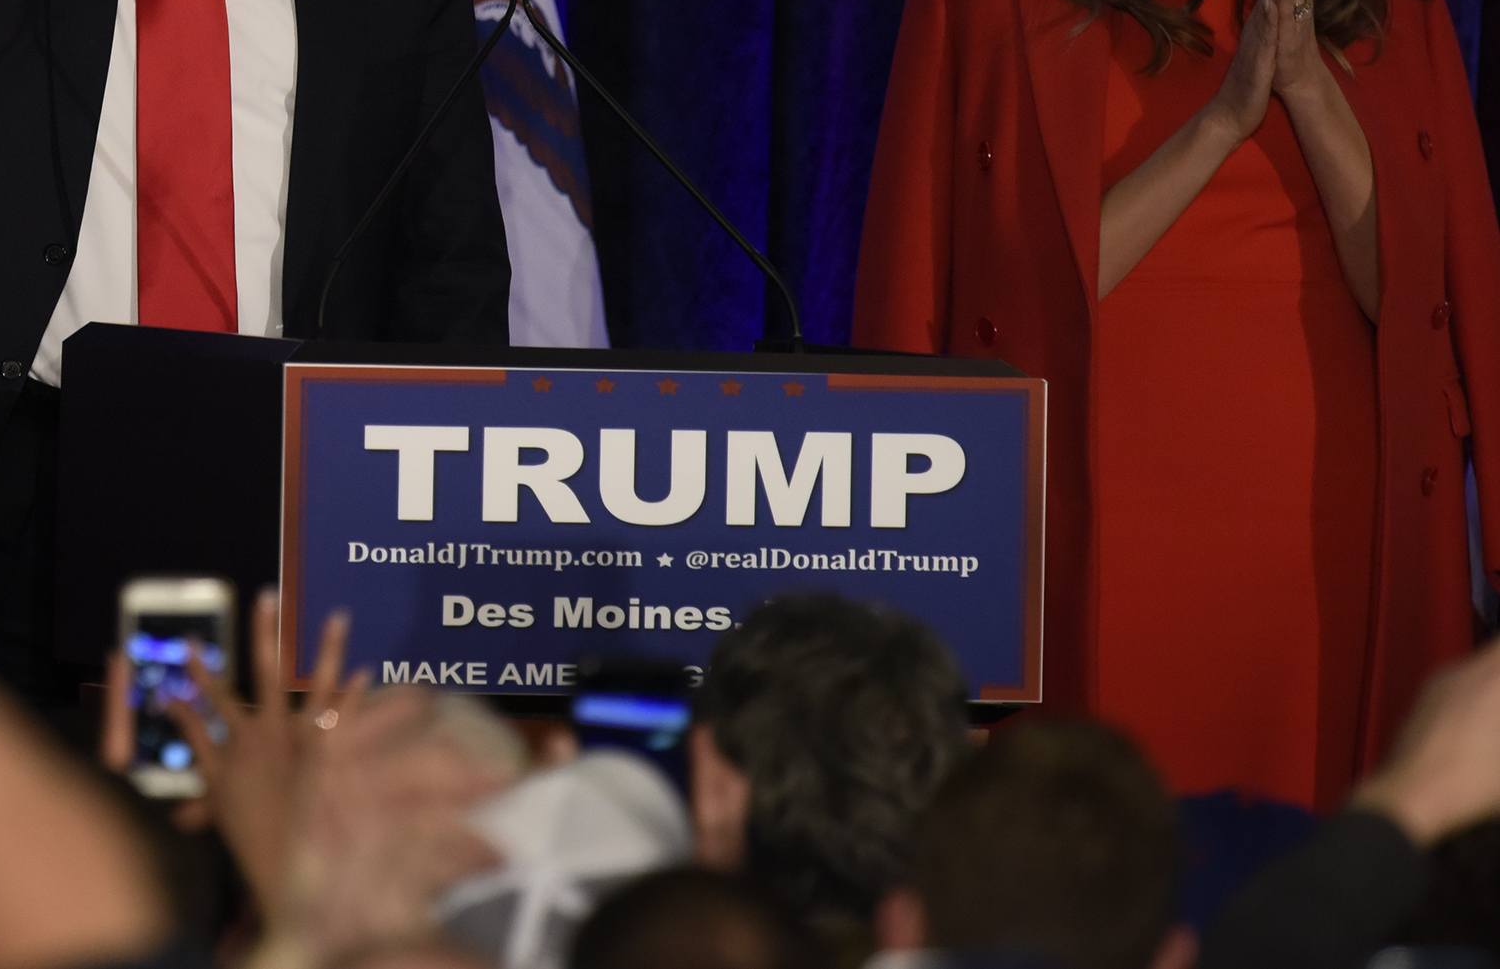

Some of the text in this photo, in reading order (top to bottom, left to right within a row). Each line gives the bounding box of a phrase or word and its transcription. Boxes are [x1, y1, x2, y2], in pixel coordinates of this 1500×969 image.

[363, 424, 966, 529] TRUMP
[347, 540, 980, 578] DonaldJTrump.com @realDonaldTrump
[442, 594, 535, 628] Des
[382, 660, 488, 685] MAKE
